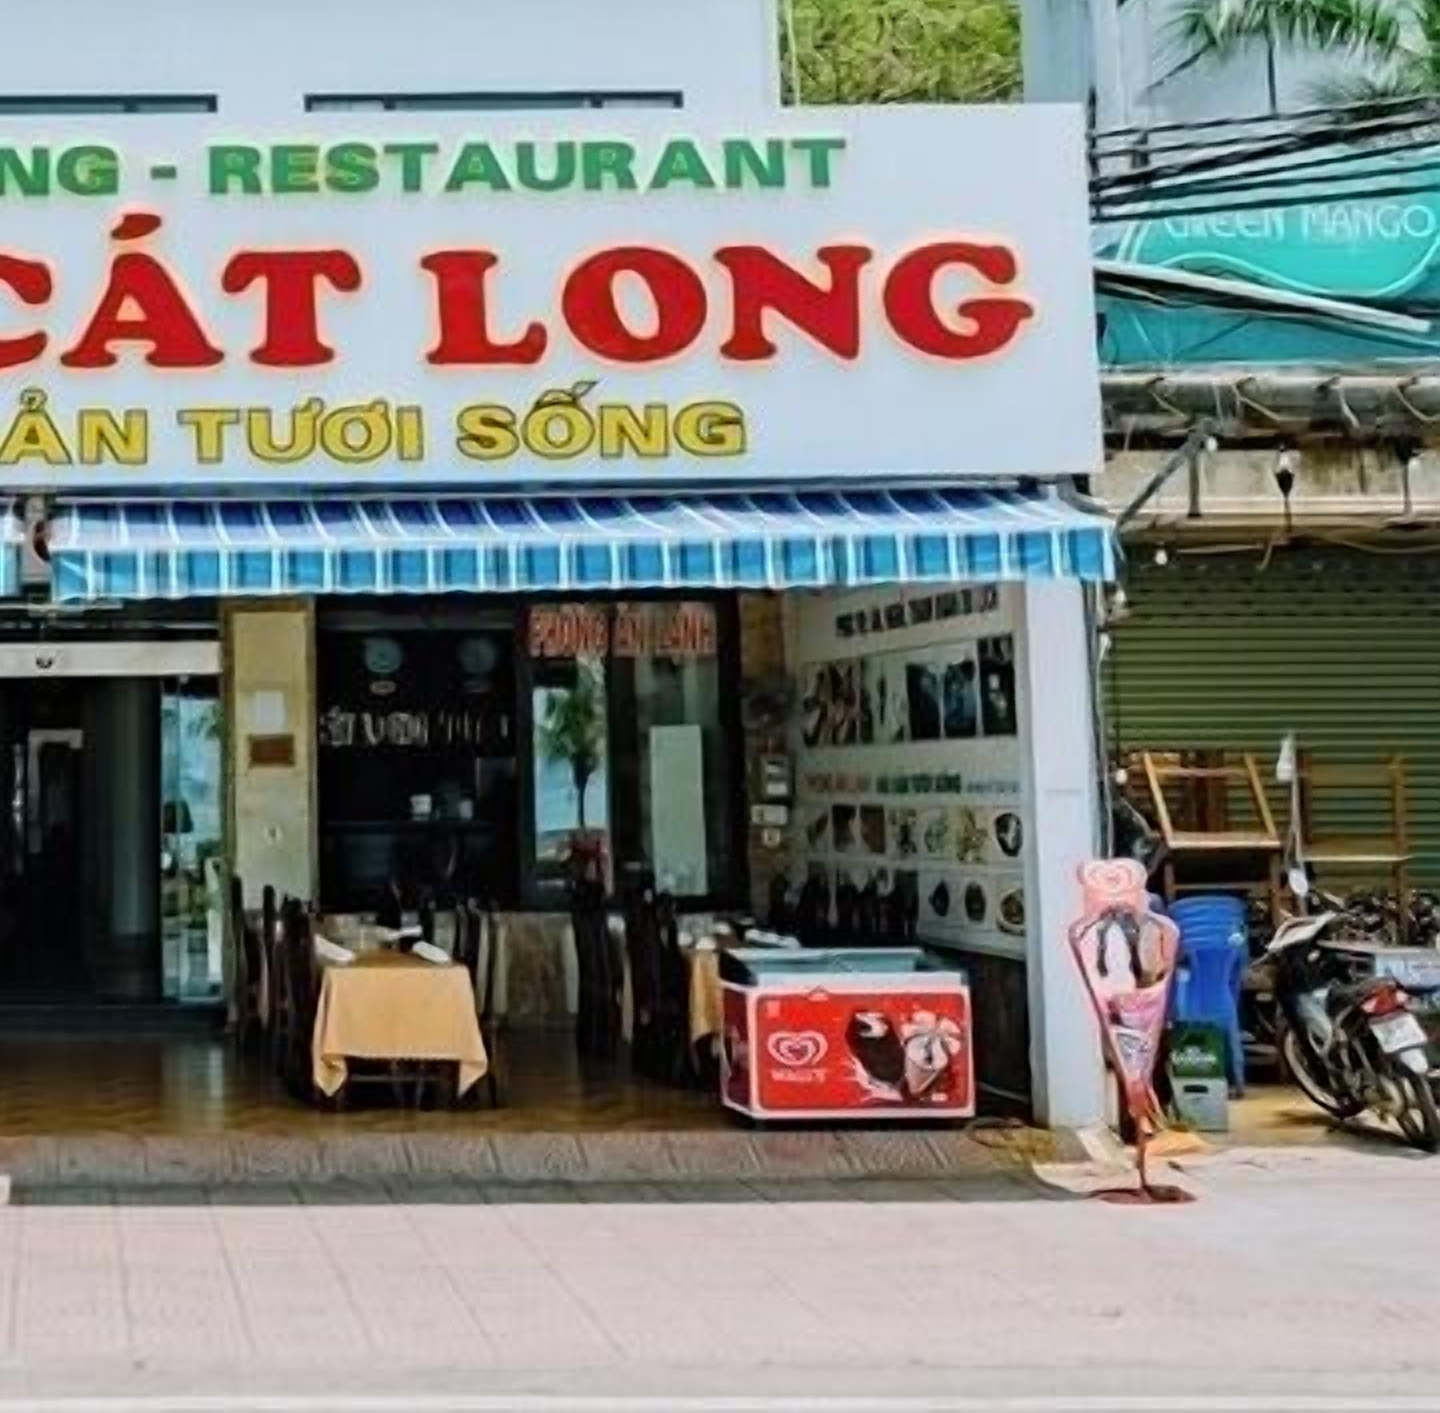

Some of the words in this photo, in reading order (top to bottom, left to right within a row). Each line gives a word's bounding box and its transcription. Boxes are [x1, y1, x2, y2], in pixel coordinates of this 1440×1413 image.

[208, 137, 847, 196] RESTAURANT
[421, 242, 1034, 366] LONG
[179, 397, 424, 465] TƯƠI
[456, 380, 748, 461] SỐNG
